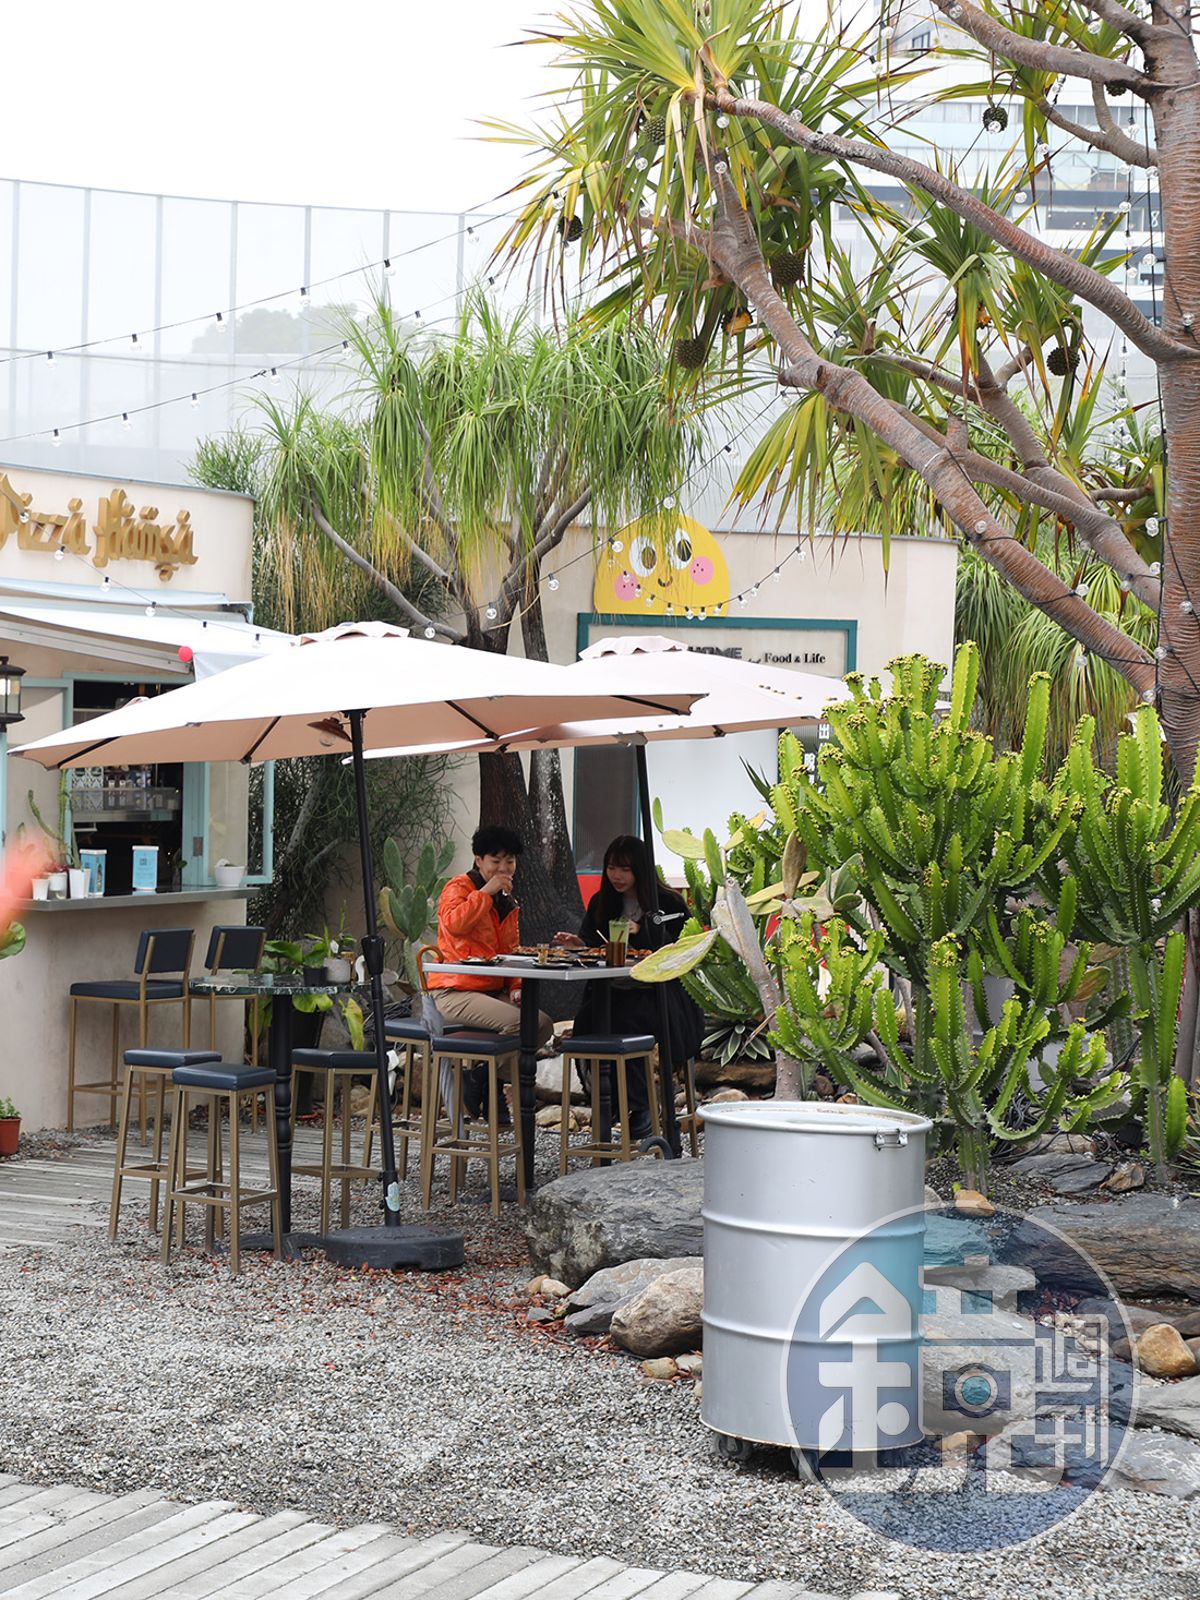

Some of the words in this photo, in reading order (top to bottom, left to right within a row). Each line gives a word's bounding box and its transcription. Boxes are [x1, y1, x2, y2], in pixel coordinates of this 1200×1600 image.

[764, 653, 792, 663] Food
[794, 655, 801, 663] &
[804, 653, 826, 663] Life
